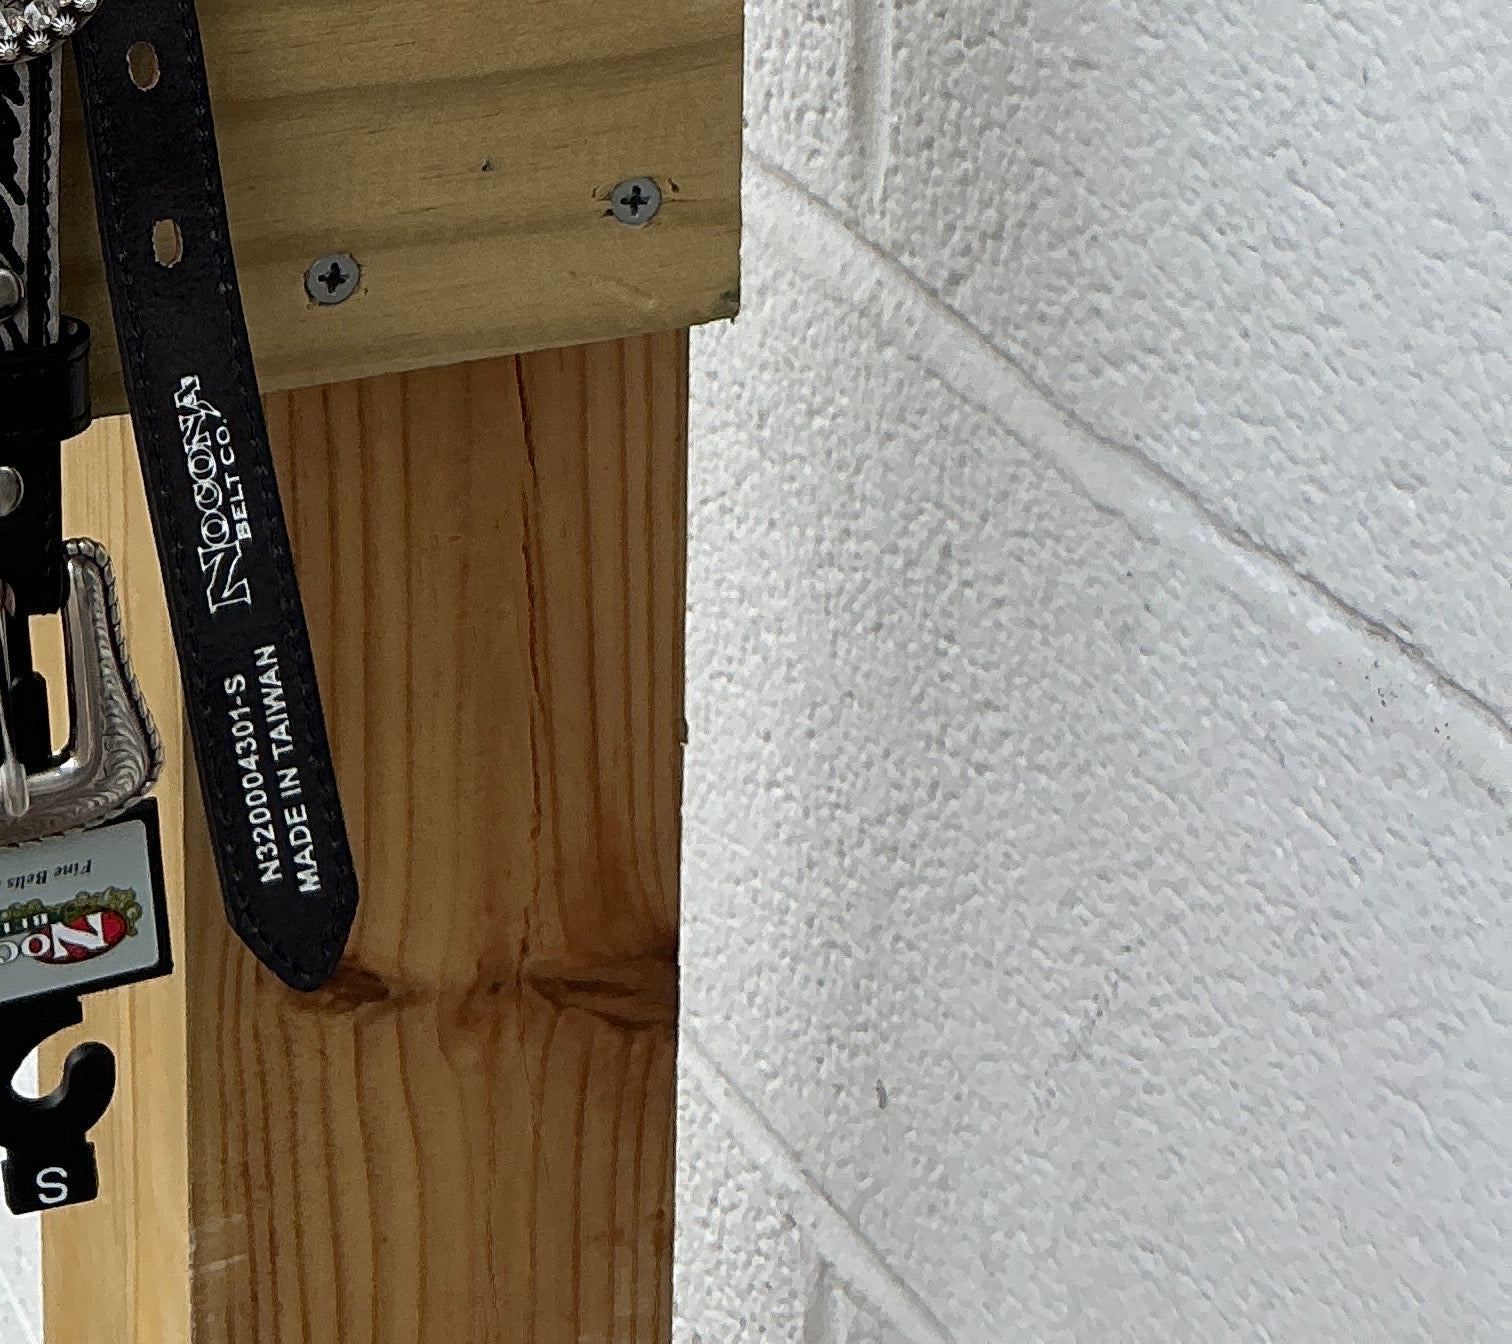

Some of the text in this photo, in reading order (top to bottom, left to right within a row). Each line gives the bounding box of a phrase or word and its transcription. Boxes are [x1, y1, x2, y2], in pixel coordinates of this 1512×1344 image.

[174, 375, 251, 614] NOCONA
[216, 418, 252, 542] BELT CO.
[224, 673, 283, 884] N320004301-S
[254, 644, 322, 893] MADE IN TAIWAN
[7, 869, 48, 890] Belts
[54, 859, 92, 877] Fine
[36, 1167, 69, 1204] S
